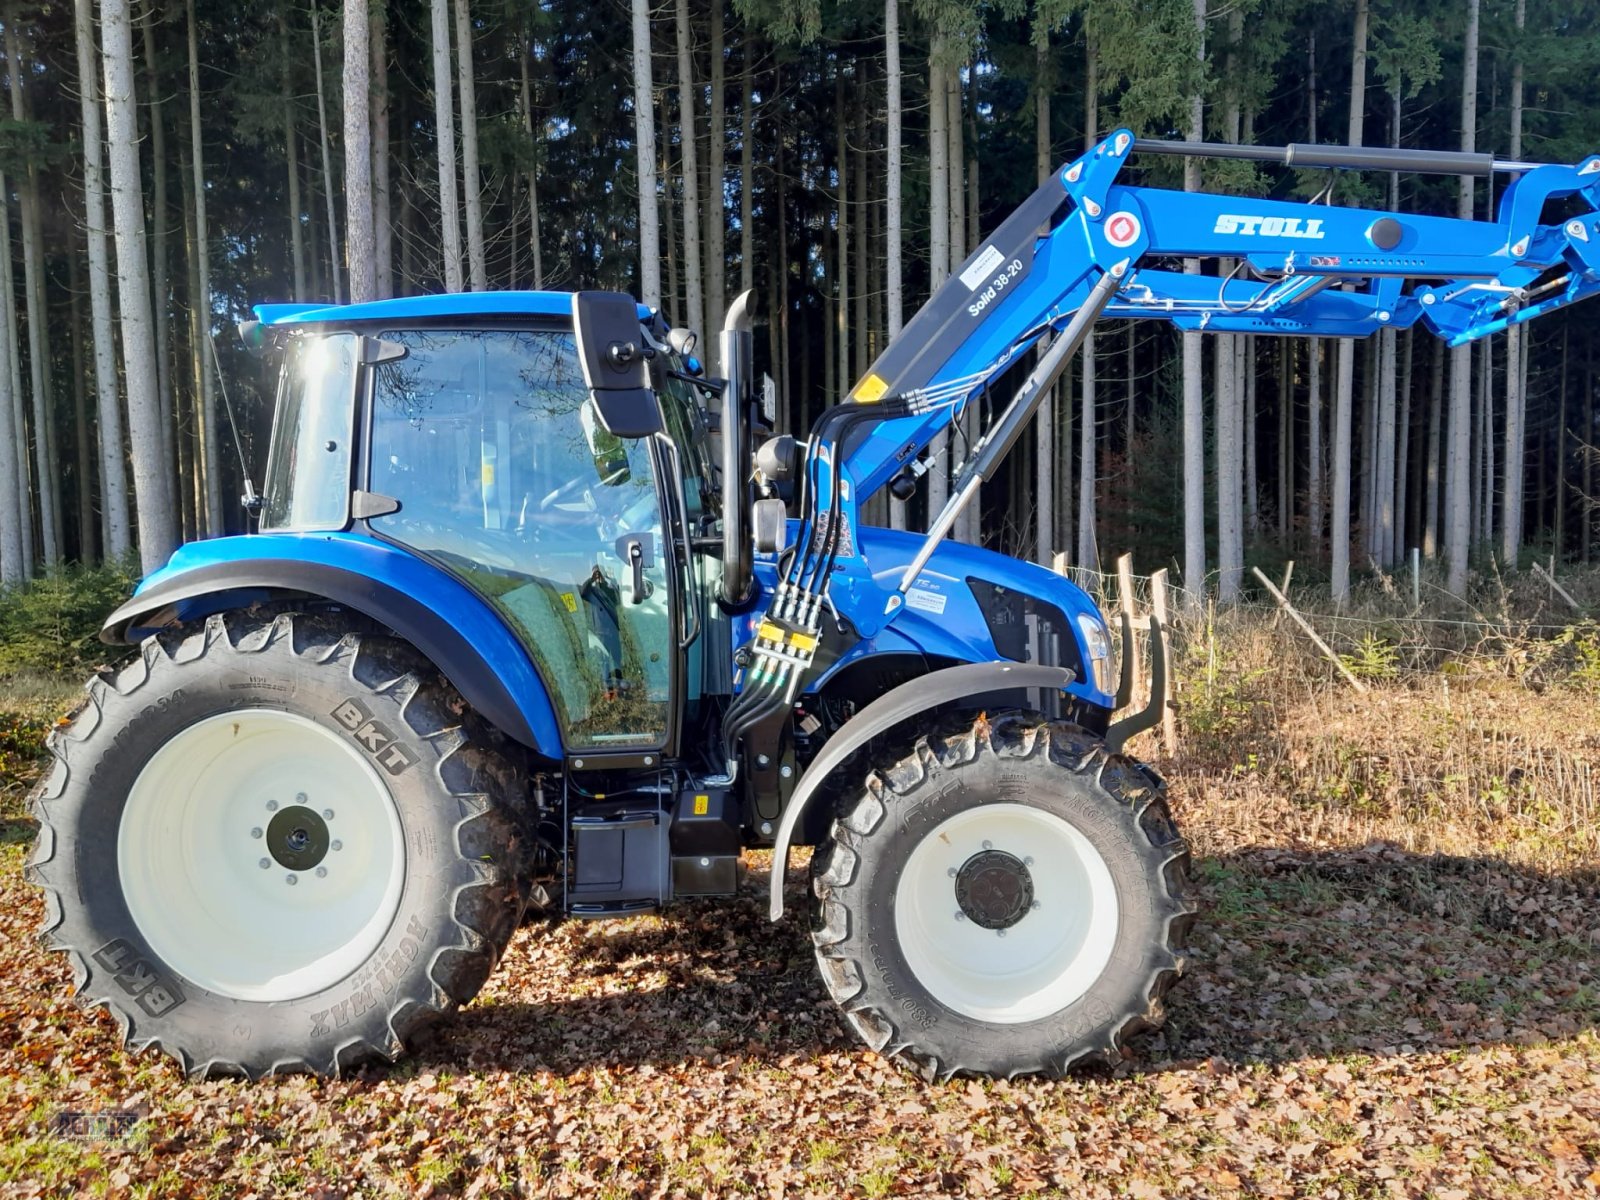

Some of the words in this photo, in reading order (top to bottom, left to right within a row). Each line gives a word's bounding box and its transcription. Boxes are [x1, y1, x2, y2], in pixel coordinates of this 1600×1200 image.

[1213, 214, 1326, 239] STOLL
[968, 286, 997, 317] Solid
[993, 259, 1023, 290] 38-20
[332, 698, 415, 772] BKT
[96, 942, 179, 1016] BKT
[310, 914, 428, 1038] AGRIMAX
